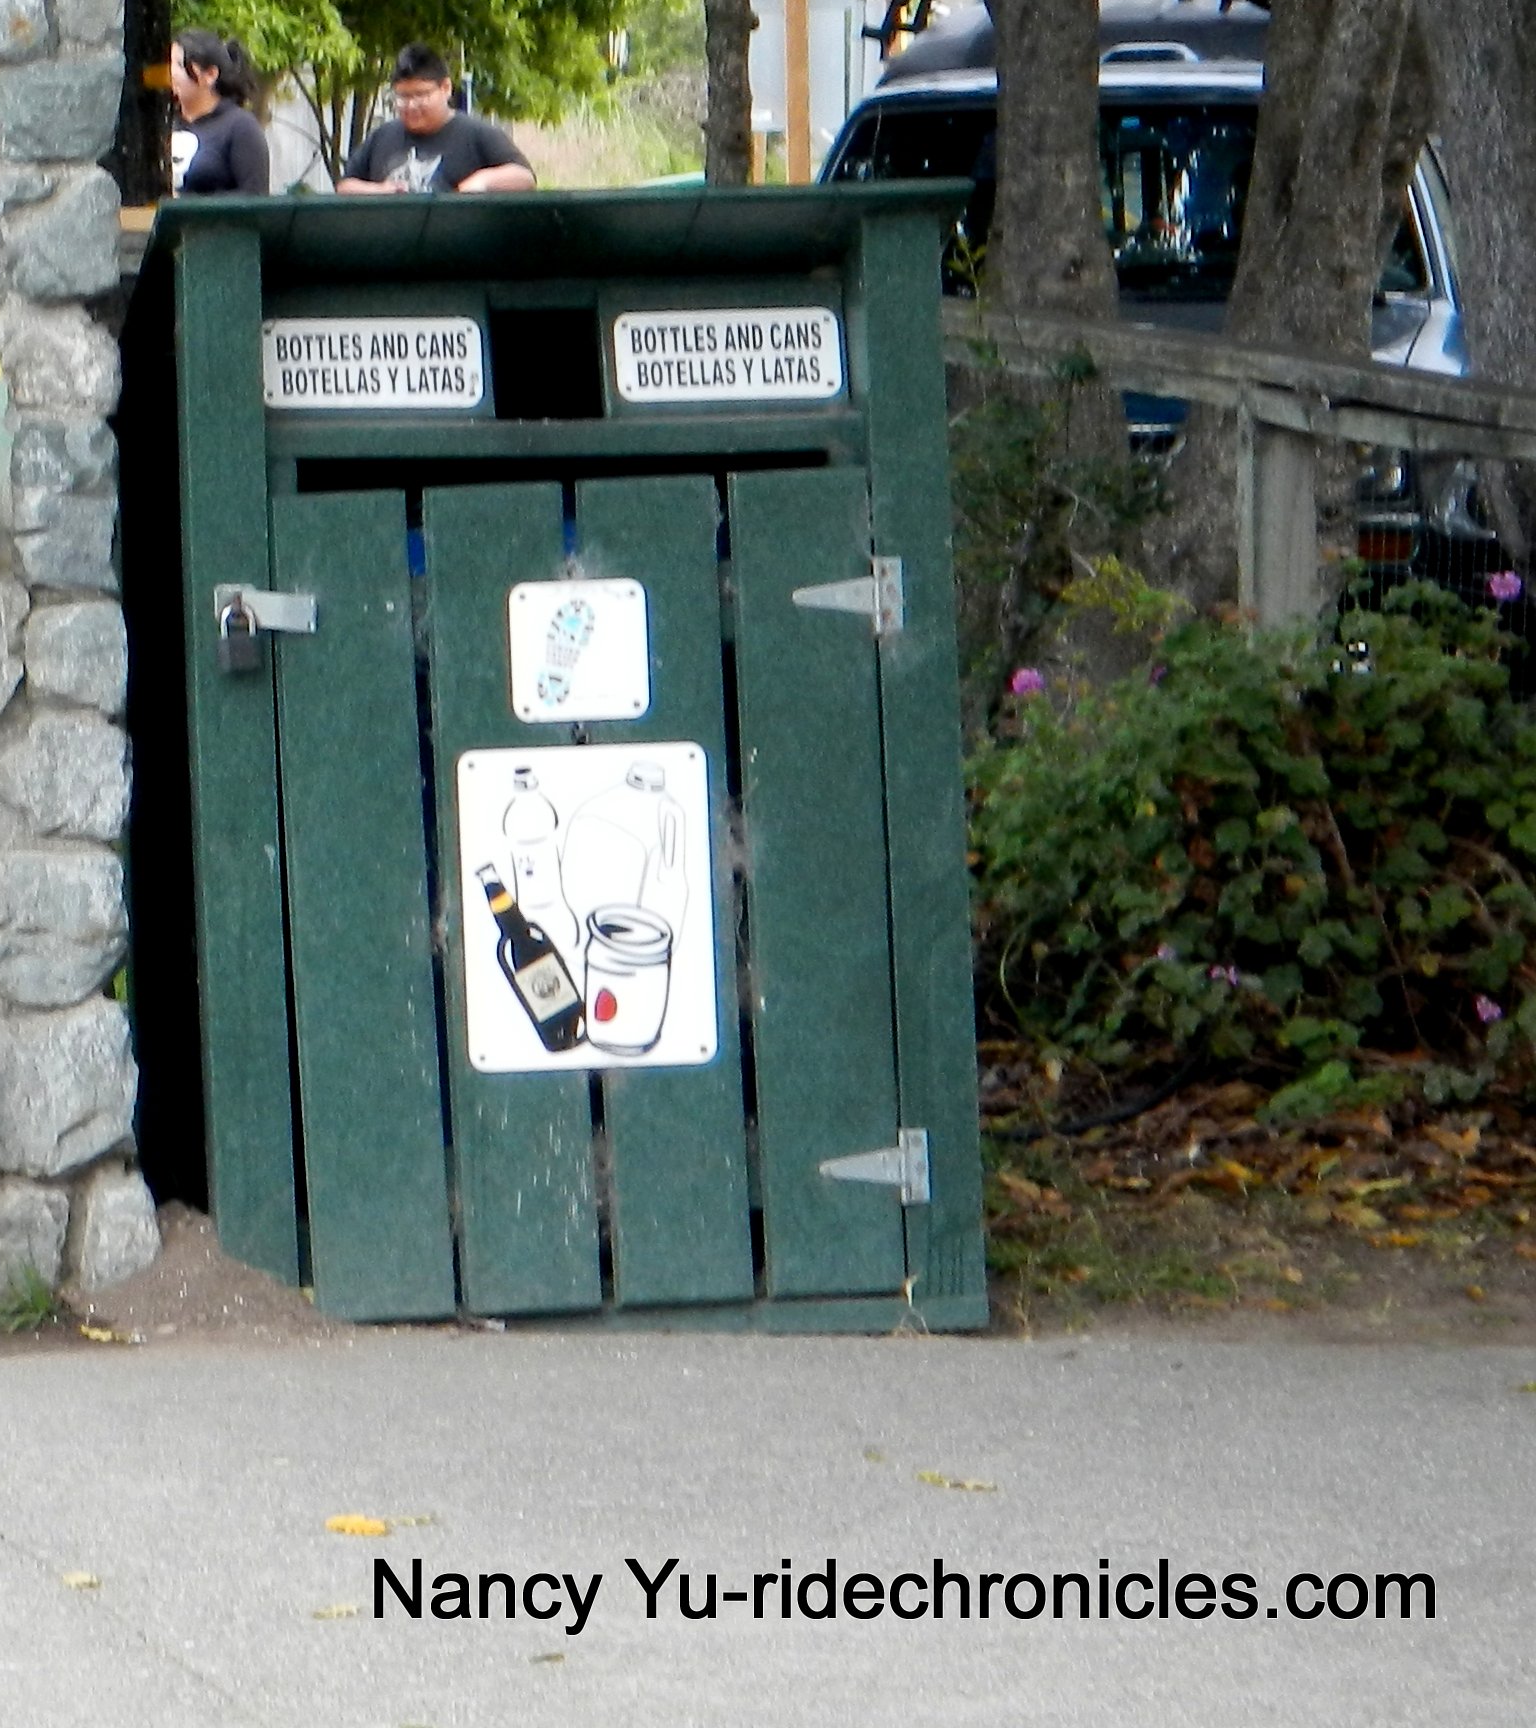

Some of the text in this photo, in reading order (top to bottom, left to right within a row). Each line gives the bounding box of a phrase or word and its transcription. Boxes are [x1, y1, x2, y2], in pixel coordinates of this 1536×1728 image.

[276, 331, 468, 362] BOTTLES AND CANS
[630, 321, 822, 354] BOTTLES AND CANS
[281, 365, 466, 396] BOTELLAS Y LATAS
[637, 356, 821, 388] BOTELLAS Y LATAS
